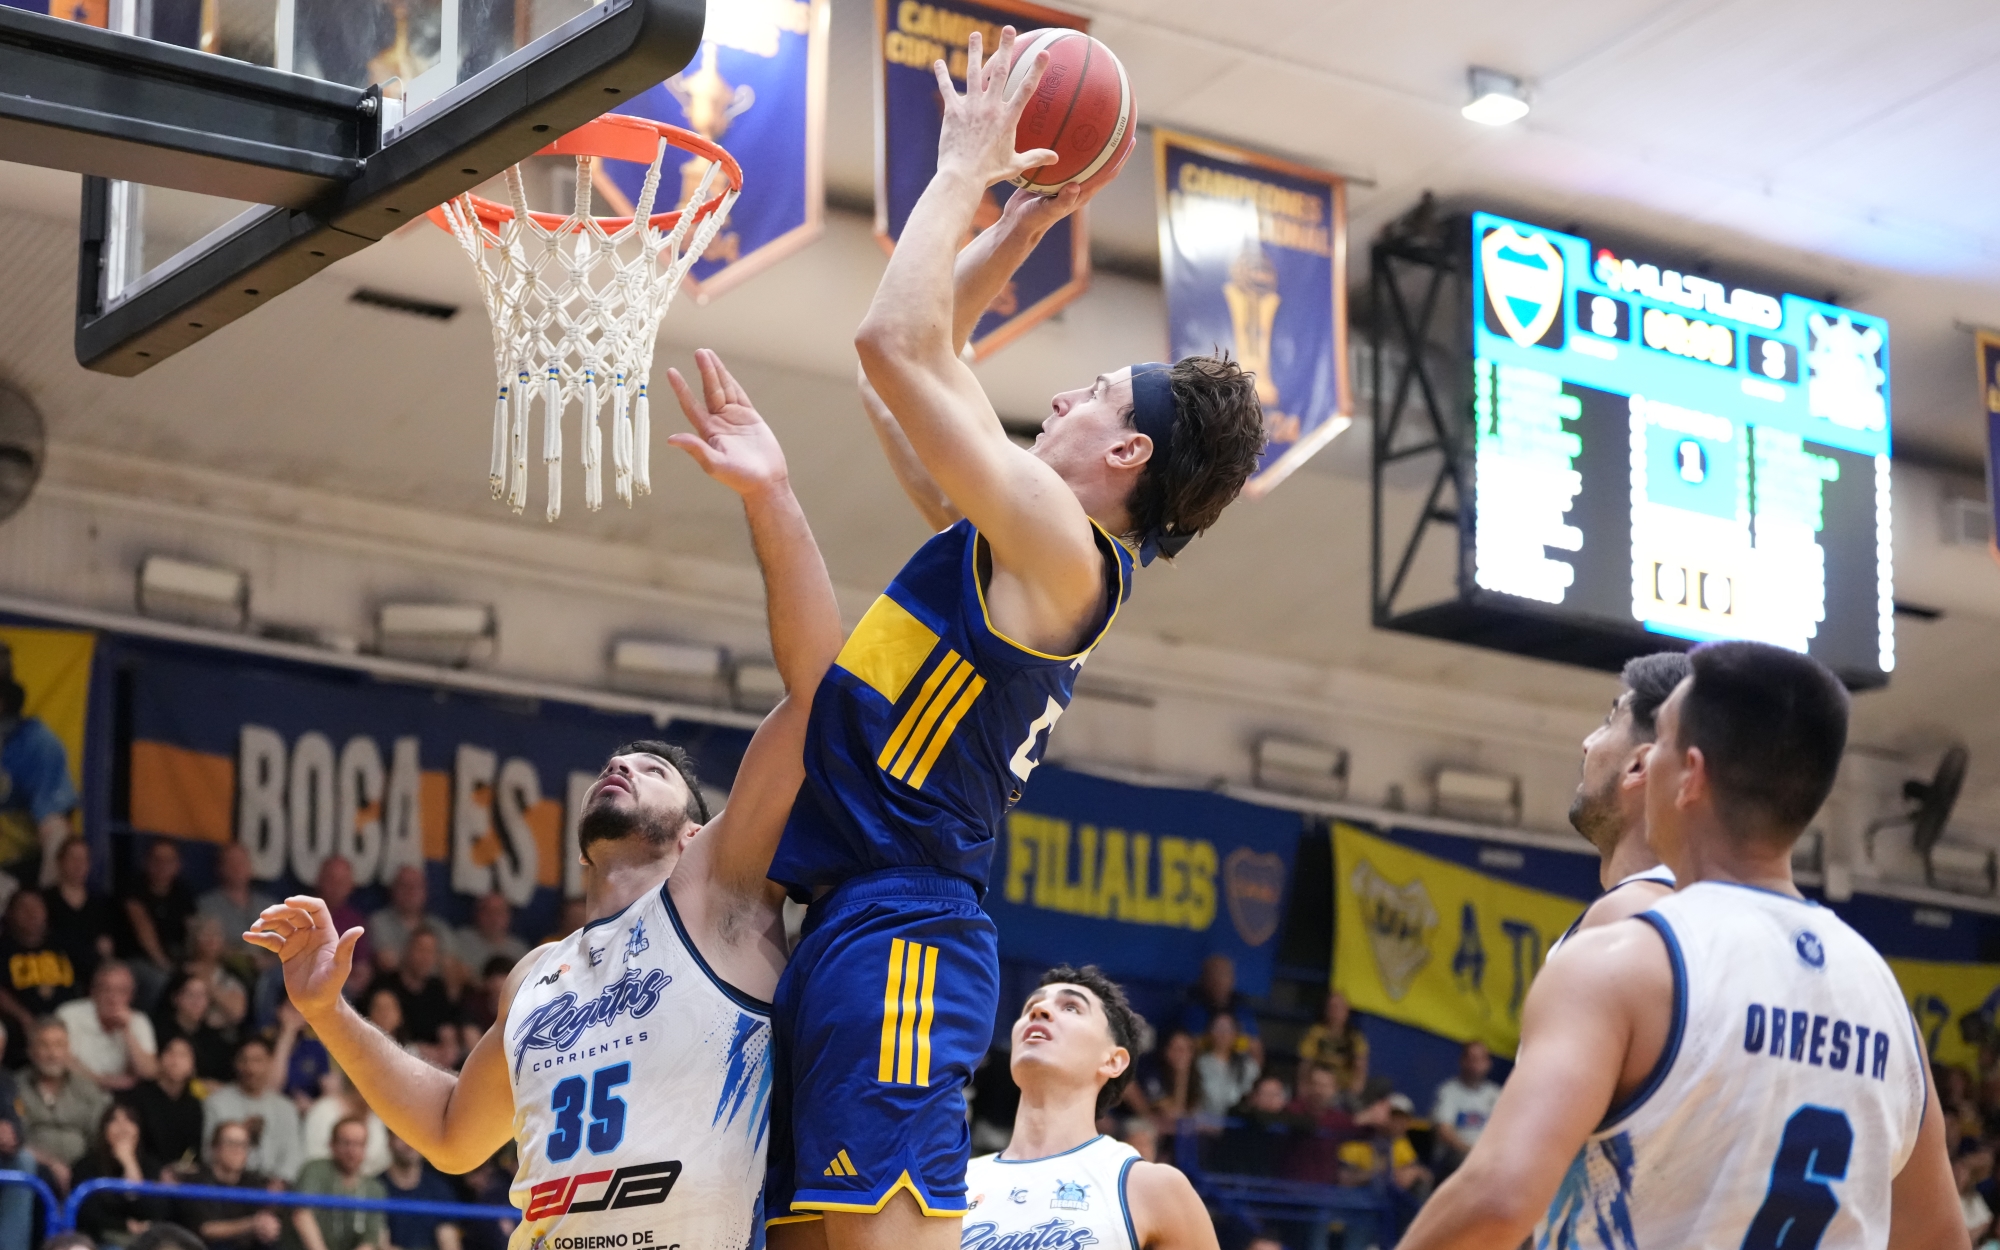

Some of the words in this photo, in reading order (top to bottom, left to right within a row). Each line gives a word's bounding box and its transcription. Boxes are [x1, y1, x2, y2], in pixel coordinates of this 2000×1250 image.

[1679, 440, 1704, 484] 1
[240, 723, 426, 888] BOCA
[452, 743, 541, 908] ES
[1004, 810, 1218, 932] FILIALES
[513, 968, 672, 1086] Regatas
[533, 1031, 648, 1072] CORRIENTES
[1743, 1002, 1890, 1082] ORRESTA
[545, 1060, 631, 1164] 35
[1740, 1102, 1855, 1250] 6
[554, 1233, 628, 1250] GOBIERNO
[632, 1230, 654, 1245] DE
